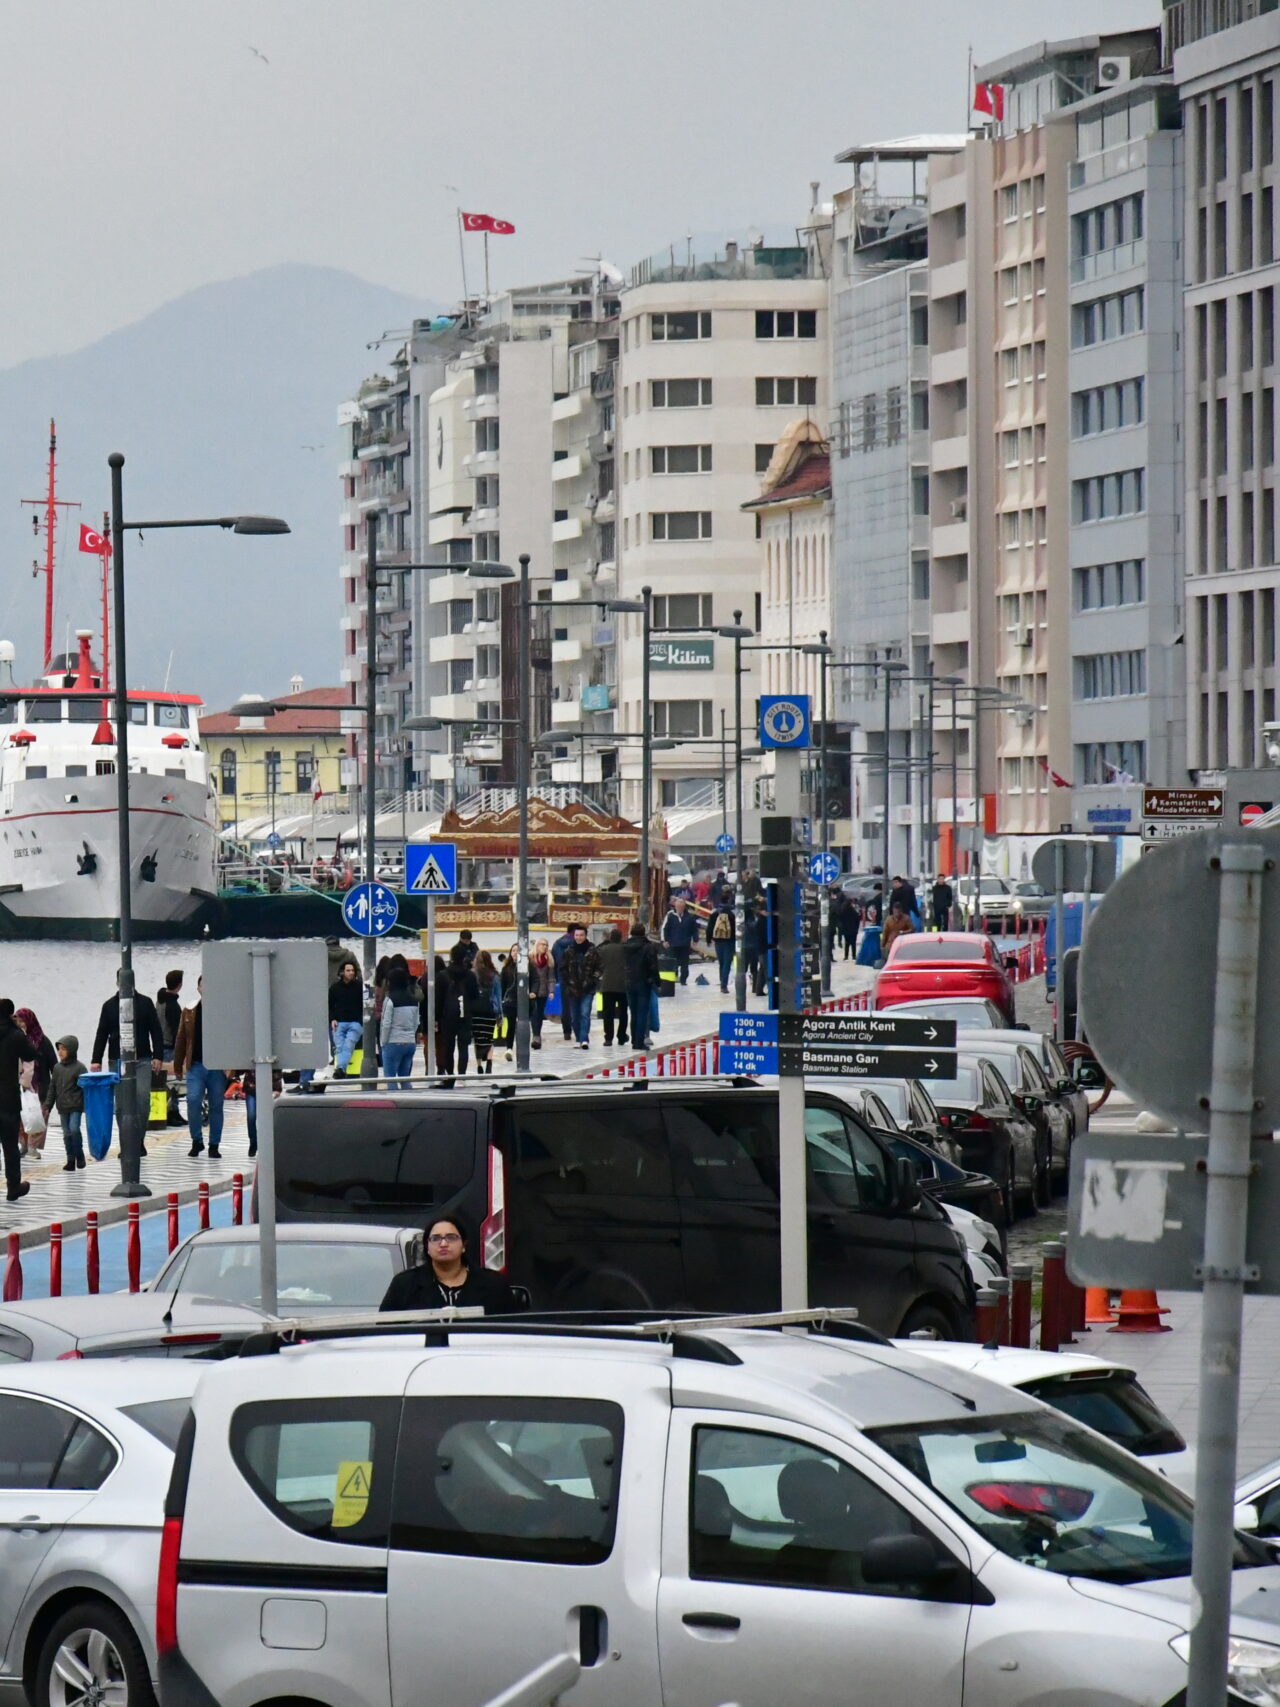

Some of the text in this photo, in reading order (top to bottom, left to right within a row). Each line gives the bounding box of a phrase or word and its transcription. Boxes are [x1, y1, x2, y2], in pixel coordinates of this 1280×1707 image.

[668, 645, 710, 664] Kilim
[767, 705, 781, 719] CITY
[734, 1018, 754, 1027] 1300
[803, 1020, 895, 1031] Agora Antik Kent
[734, 1028, 757, 1037] 16 dk
[802, 1032, 873, 1041] Agora Ancient City
[734, 1052, 754, 1061] 1100
[803, 1053, 878, 1063] Basmane Garı
[733, 1062, 756, 1070] 14 dk
[841, 1065, 868, 1073] Station
